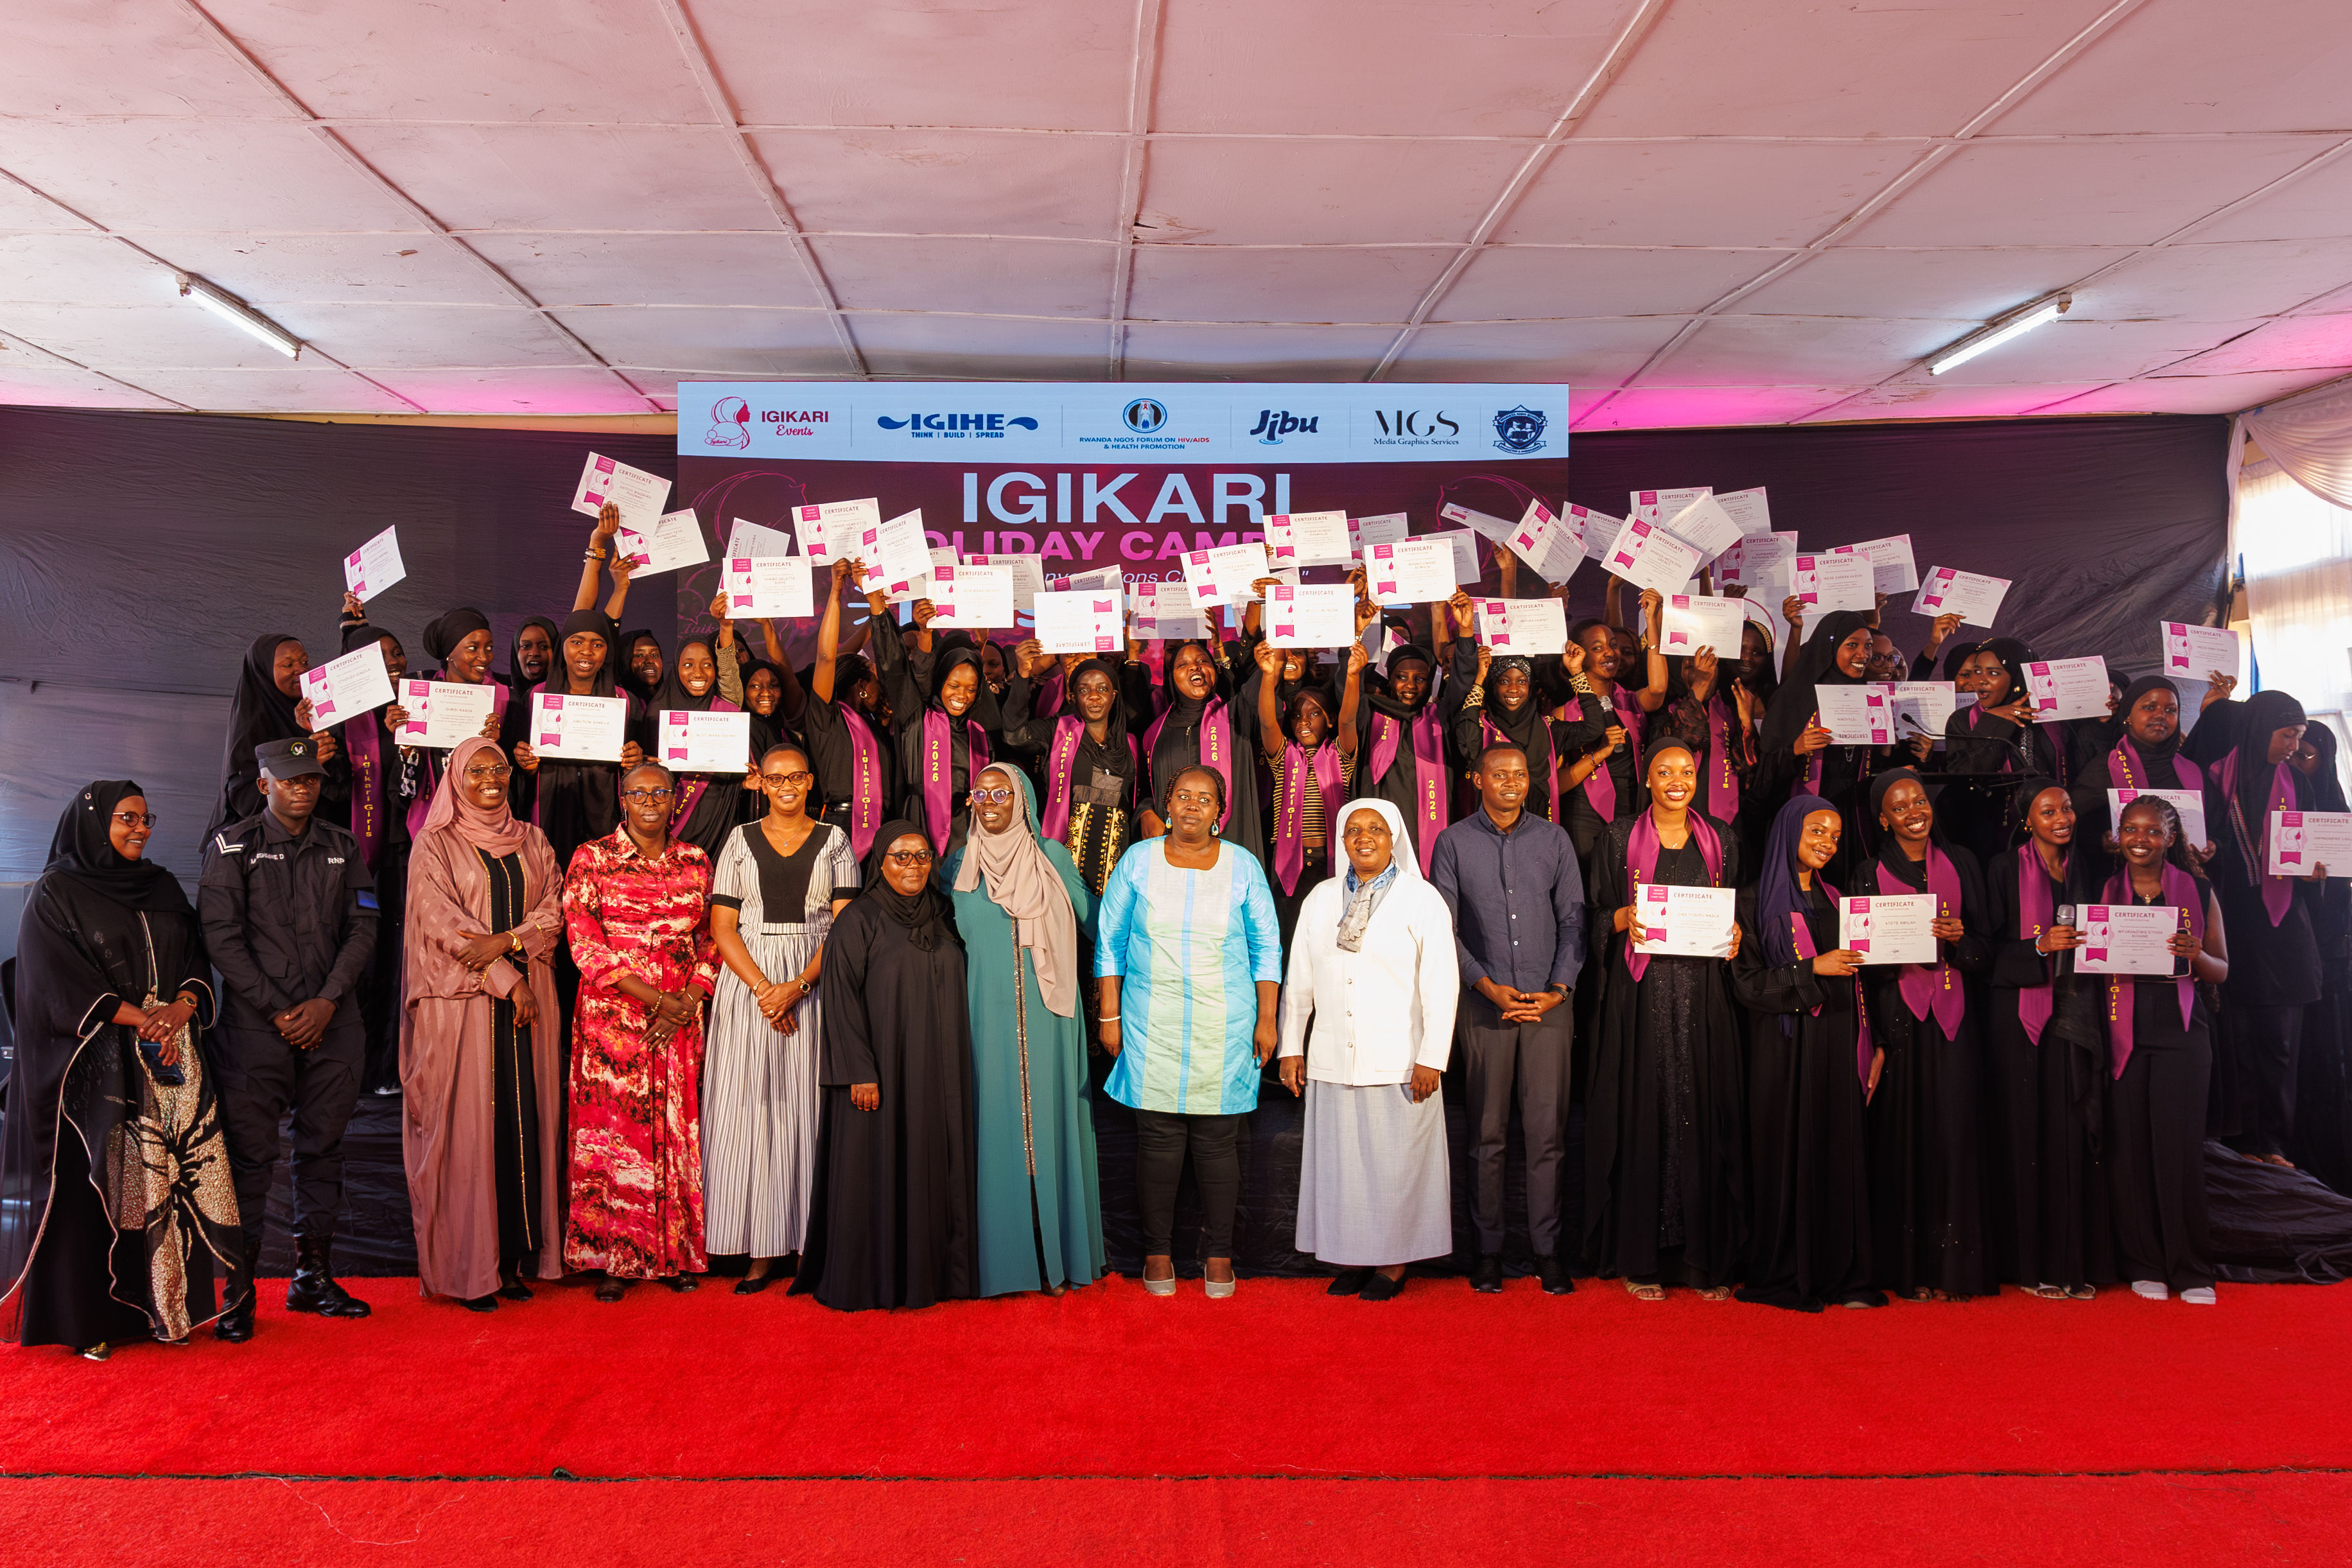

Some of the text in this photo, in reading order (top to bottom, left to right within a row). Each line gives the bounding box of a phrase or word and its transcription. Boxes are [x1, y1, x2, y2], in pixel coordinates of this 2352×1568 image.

[762, 411, 828, 422] IGIKARI
[911, 414, 1004, 430] IGIHE
[1250, 410, 1318, 441] Jibu
[1374, 410, 1459, 437] MGS
[776, 424, 814, 435] Events
[1398, 438, 1429, 446] Graphics
[618, 469, 652, 484] CERTIFICATE
[964, 472, 1290, 524] IGIKARI
[1718, 494, 1748, 503] CERTIFICATE
[824, 506, 859, 514] CERTIFICATE
[880, 520, 907, 534] CERTIFICATE
[1591, 514, 1622, 526] CERTIFICATE
[1551, 521, 1575, 543] CERTIFICATE
[363, 537, 385, 555] CERTIFICATE
[924, 530, 1105, 560] LIDAY
[1653, 534, 1684, 553] CERTIFICATE
[1858, 542, 1892, 552] CERTIFICATE
[1214, 549, 1246, 558] CERTIFICATE
[1074, 574, 1104, 584] CERTIFICATE
[1958, 575, 1992, 584] CERTIFICATE
[330, 654, 363, 671] CERTIFICATE
[1056, 731, 1072, 803] Igikari Girls
[1723, 759, 1731, 788] Girls
[363, 754, 373, 837] Igikari Girls
[675, 785, 695, 814] Girls
[1286, 762, 1298, 838] Igikari Girls
[1428, 780, 1436, 821] 2026
[862, 797, 871, 828] Girls
[2110, 986, 2120, 1021] Girls
